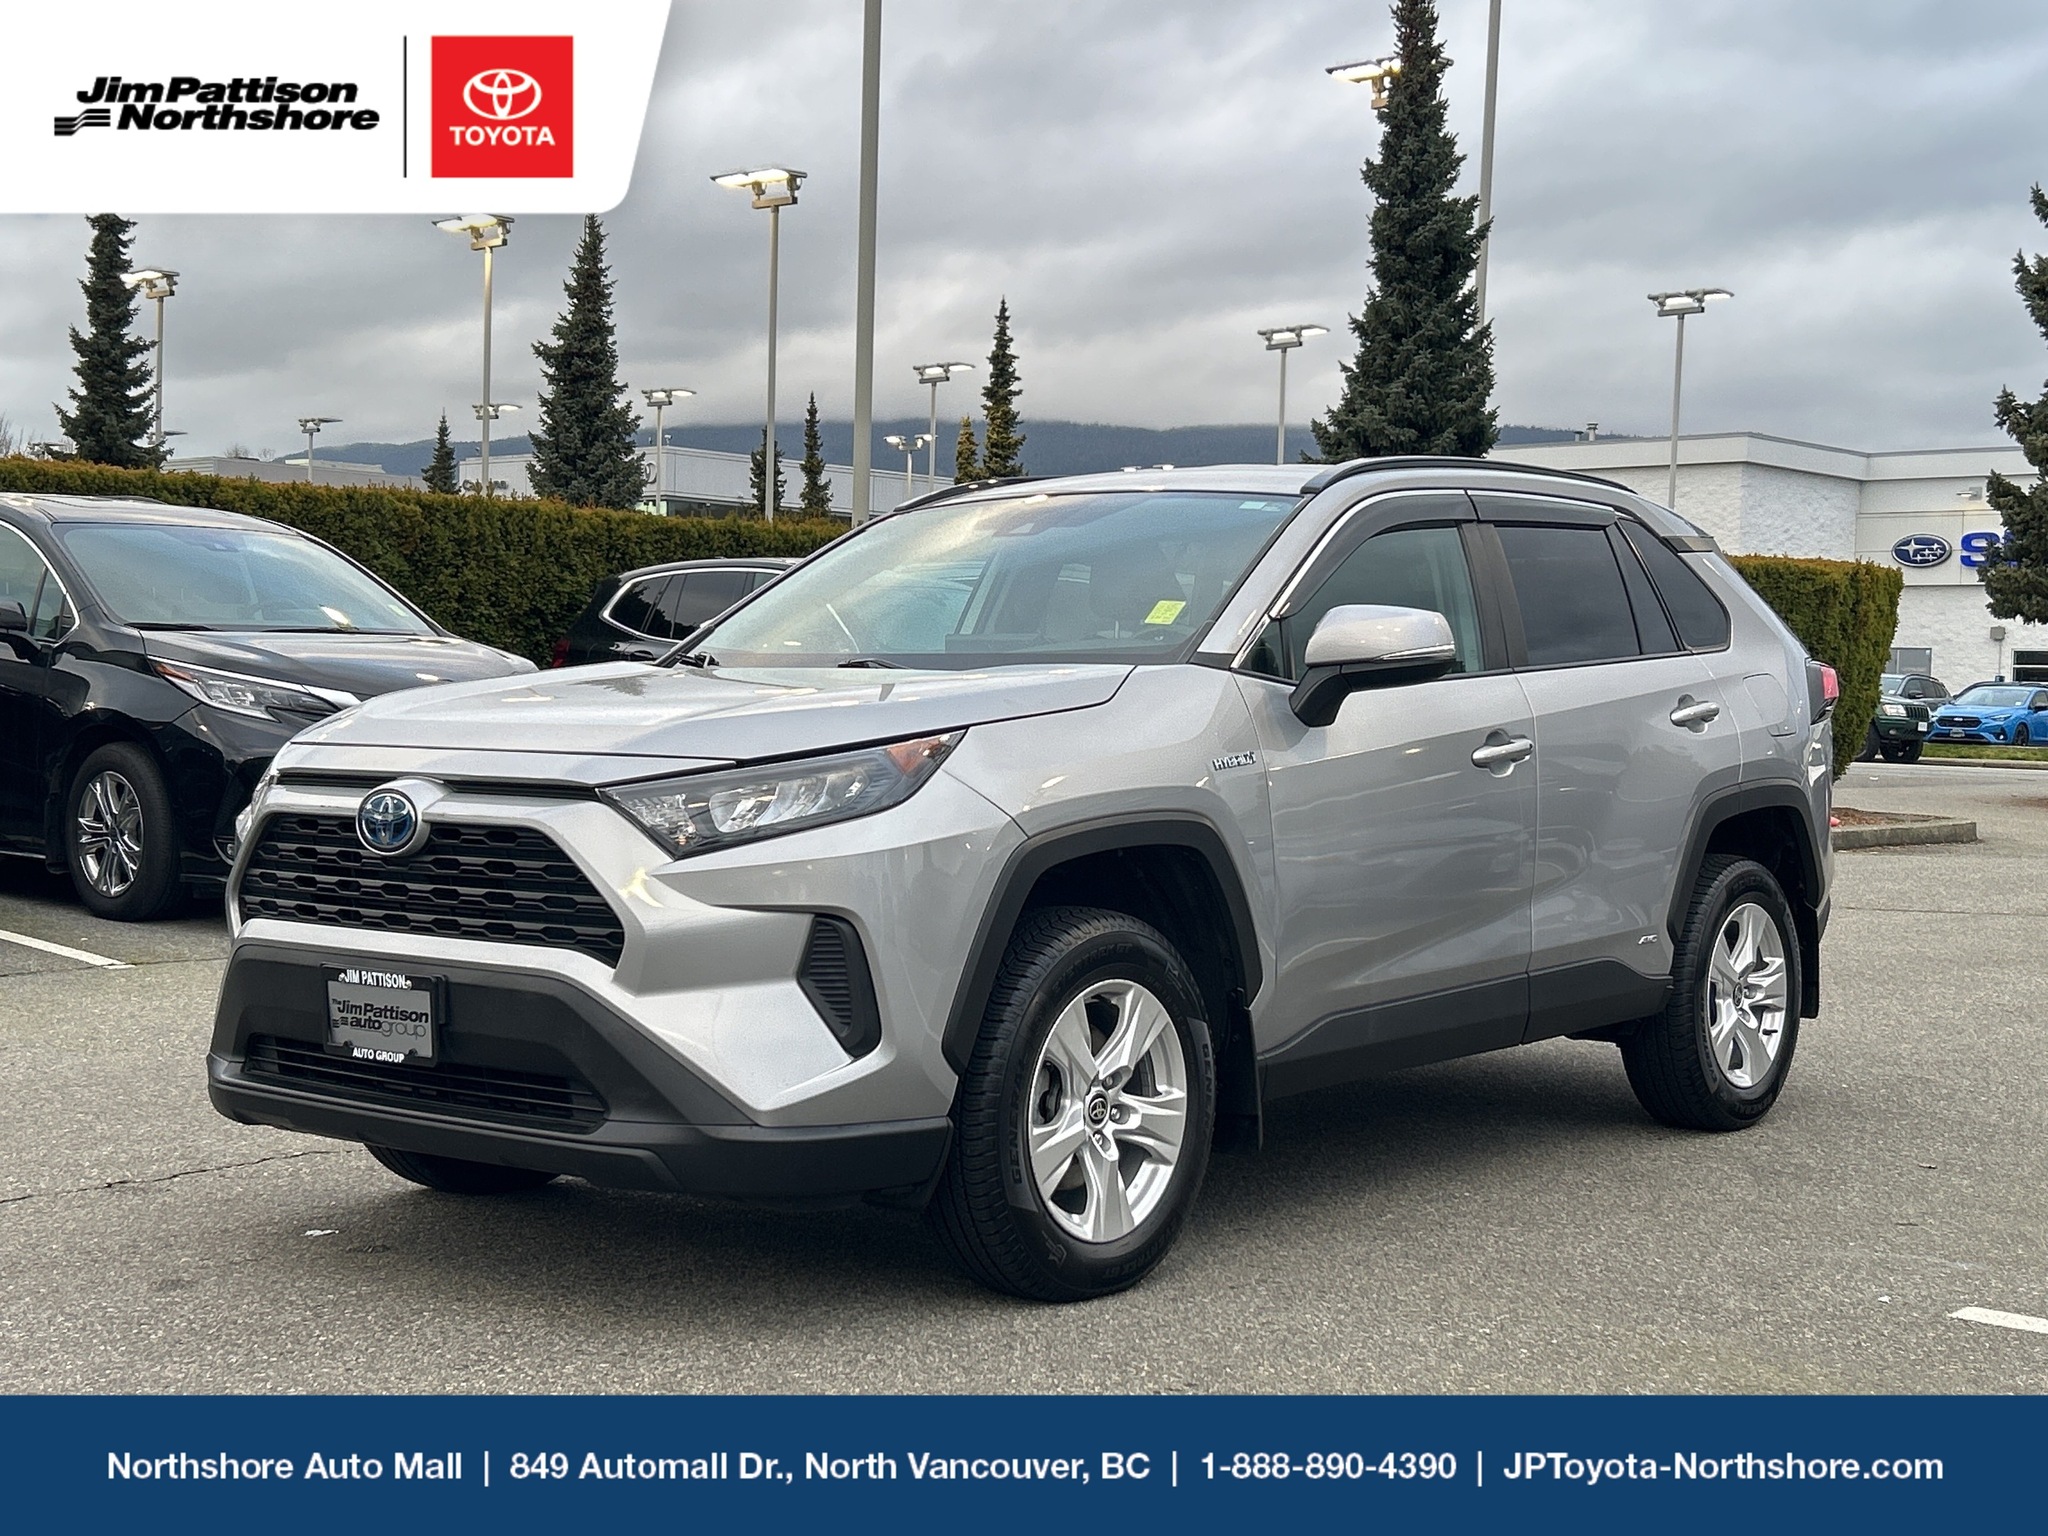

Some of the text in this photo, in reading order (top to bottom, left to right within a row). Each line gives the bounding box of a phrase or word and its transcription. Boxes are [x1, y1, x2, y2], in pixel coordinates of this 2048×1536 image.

[344, 969, 407, 989] JIM PATTISON
[352, 1047, 405, 1063] AUTO GROUP
